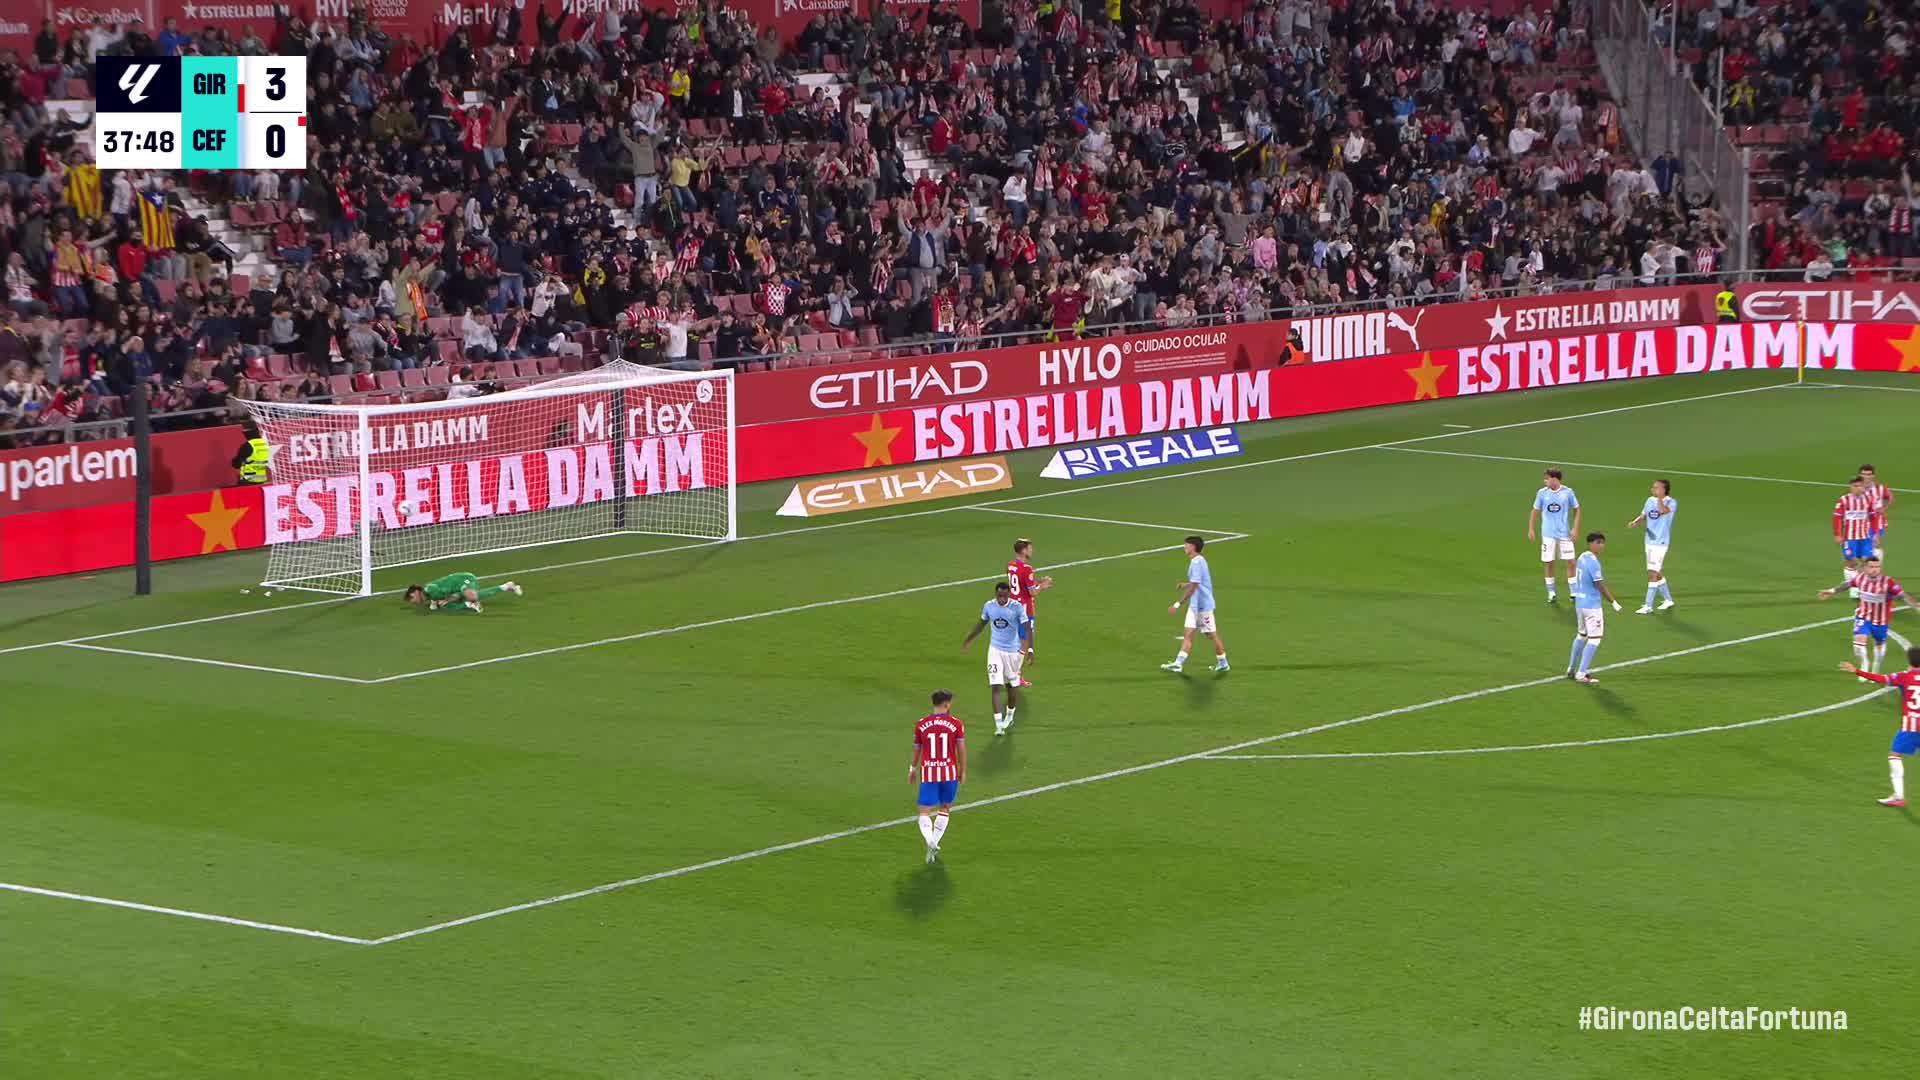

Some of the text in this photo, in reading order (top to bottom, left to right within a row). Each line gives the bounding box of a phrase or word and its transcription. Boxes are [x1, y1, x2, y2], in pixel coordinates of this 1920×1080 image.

[200, 5, 255, 19] ESTRELLA
[373, 8, 406, 16] OCULAR
[1291, 312, 1385, 362] PUMA
[1515, 298, 1680, 332] ESTRELLA DAMM
[1134, 332, 1227, 353] CUIDADO OCULAR
[1457, 322, 1856, 396] ESTRELLA DAMM
[810, 360, 988, 409] ETIHAD
[912, 369, 1272, 461] ESTRELLA DAMM
[290, 414, 488, 462] ESTRELLA DAMM
[1097, 427, 1239, 471] REALE
[262, 432, 706, 545] ESTRELLA DAMM
[807, 463, 1005, 508] ETIHAD
[988, 664, 998, 673] 23
[927, 732, 948, 759] 11
